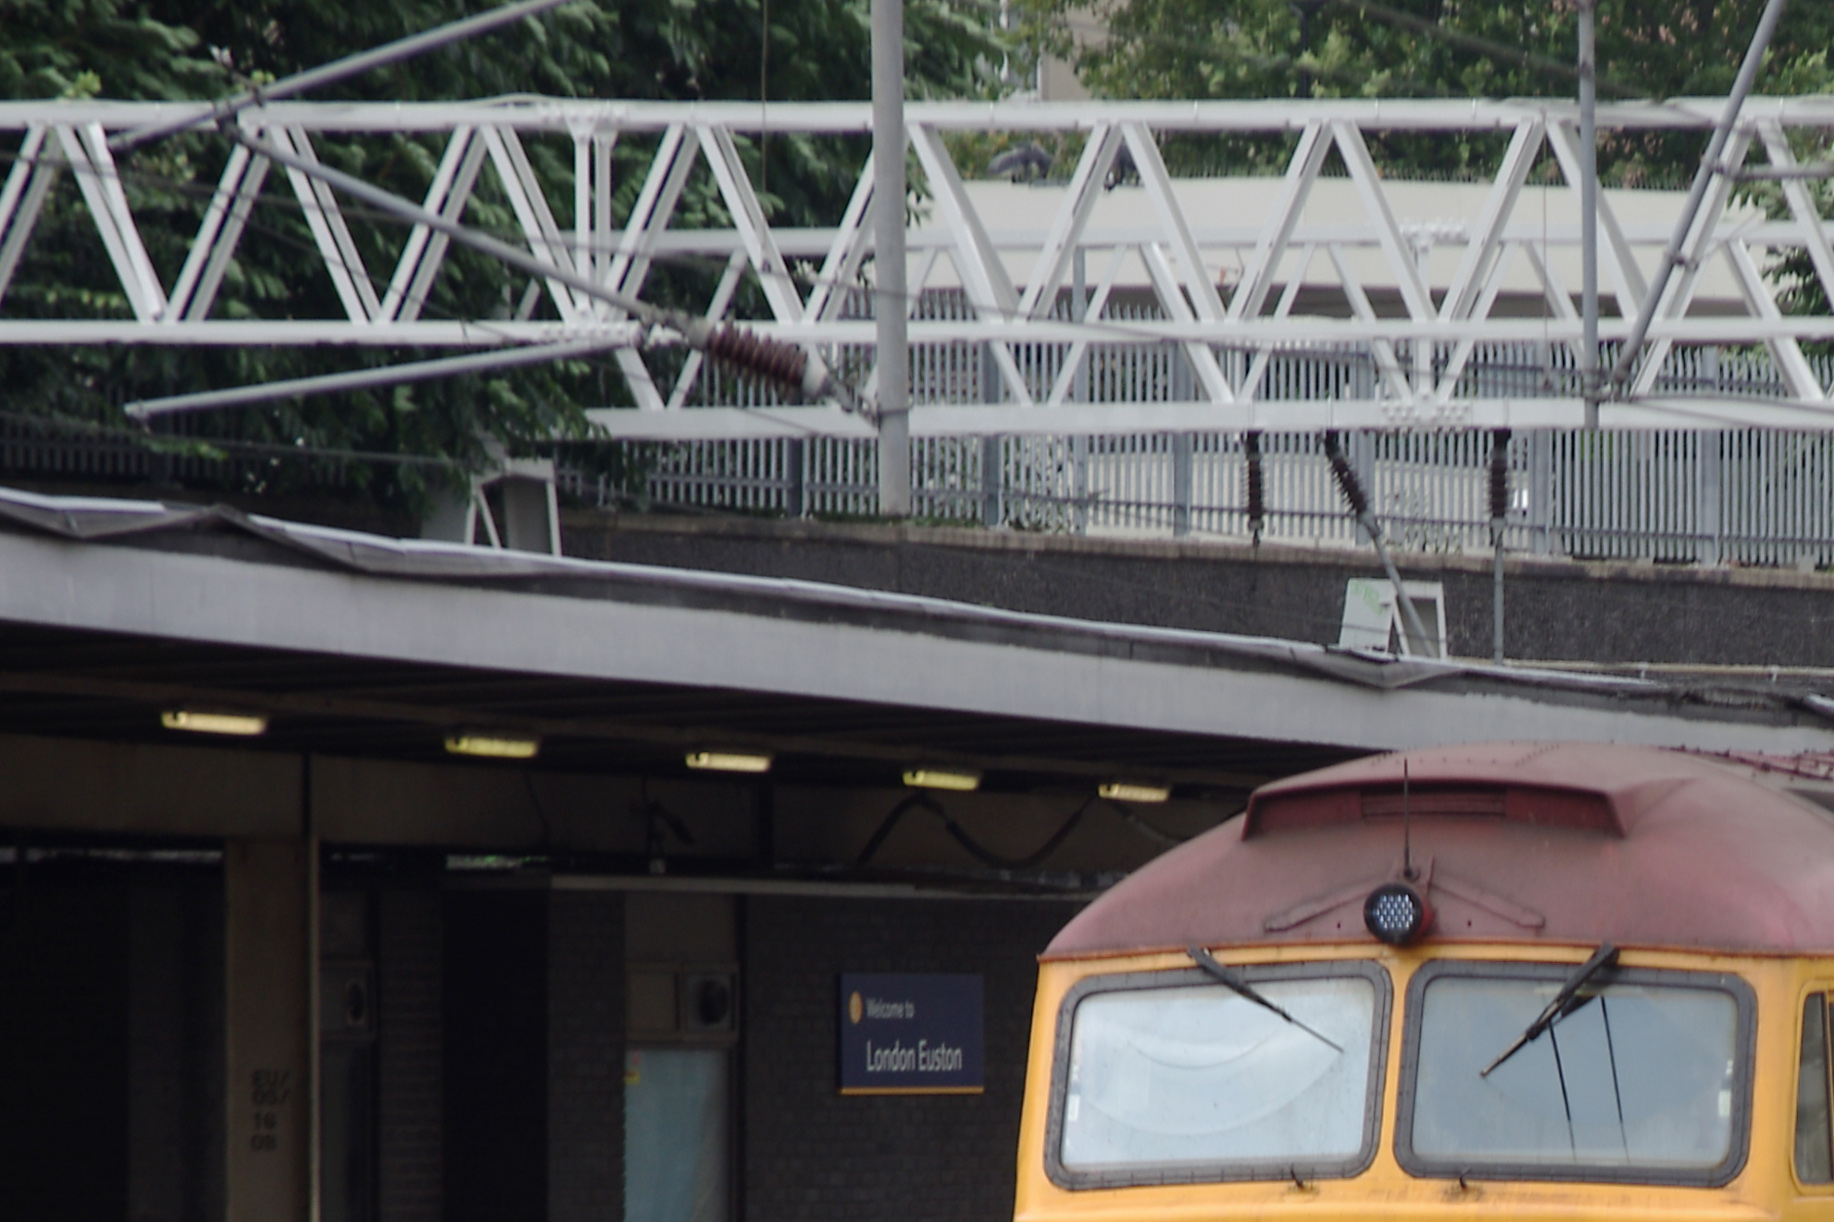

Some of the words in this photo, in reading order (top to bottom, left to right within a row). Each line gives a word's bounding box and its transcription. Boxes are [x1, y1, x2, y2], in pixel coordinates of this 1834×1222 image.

[866, 998, 903, 1019] Welcome
[905, 1001, 915, 1019] to
[866, 1039, 915, 1072] London
[918, 1038, 962, 1071] Euston
